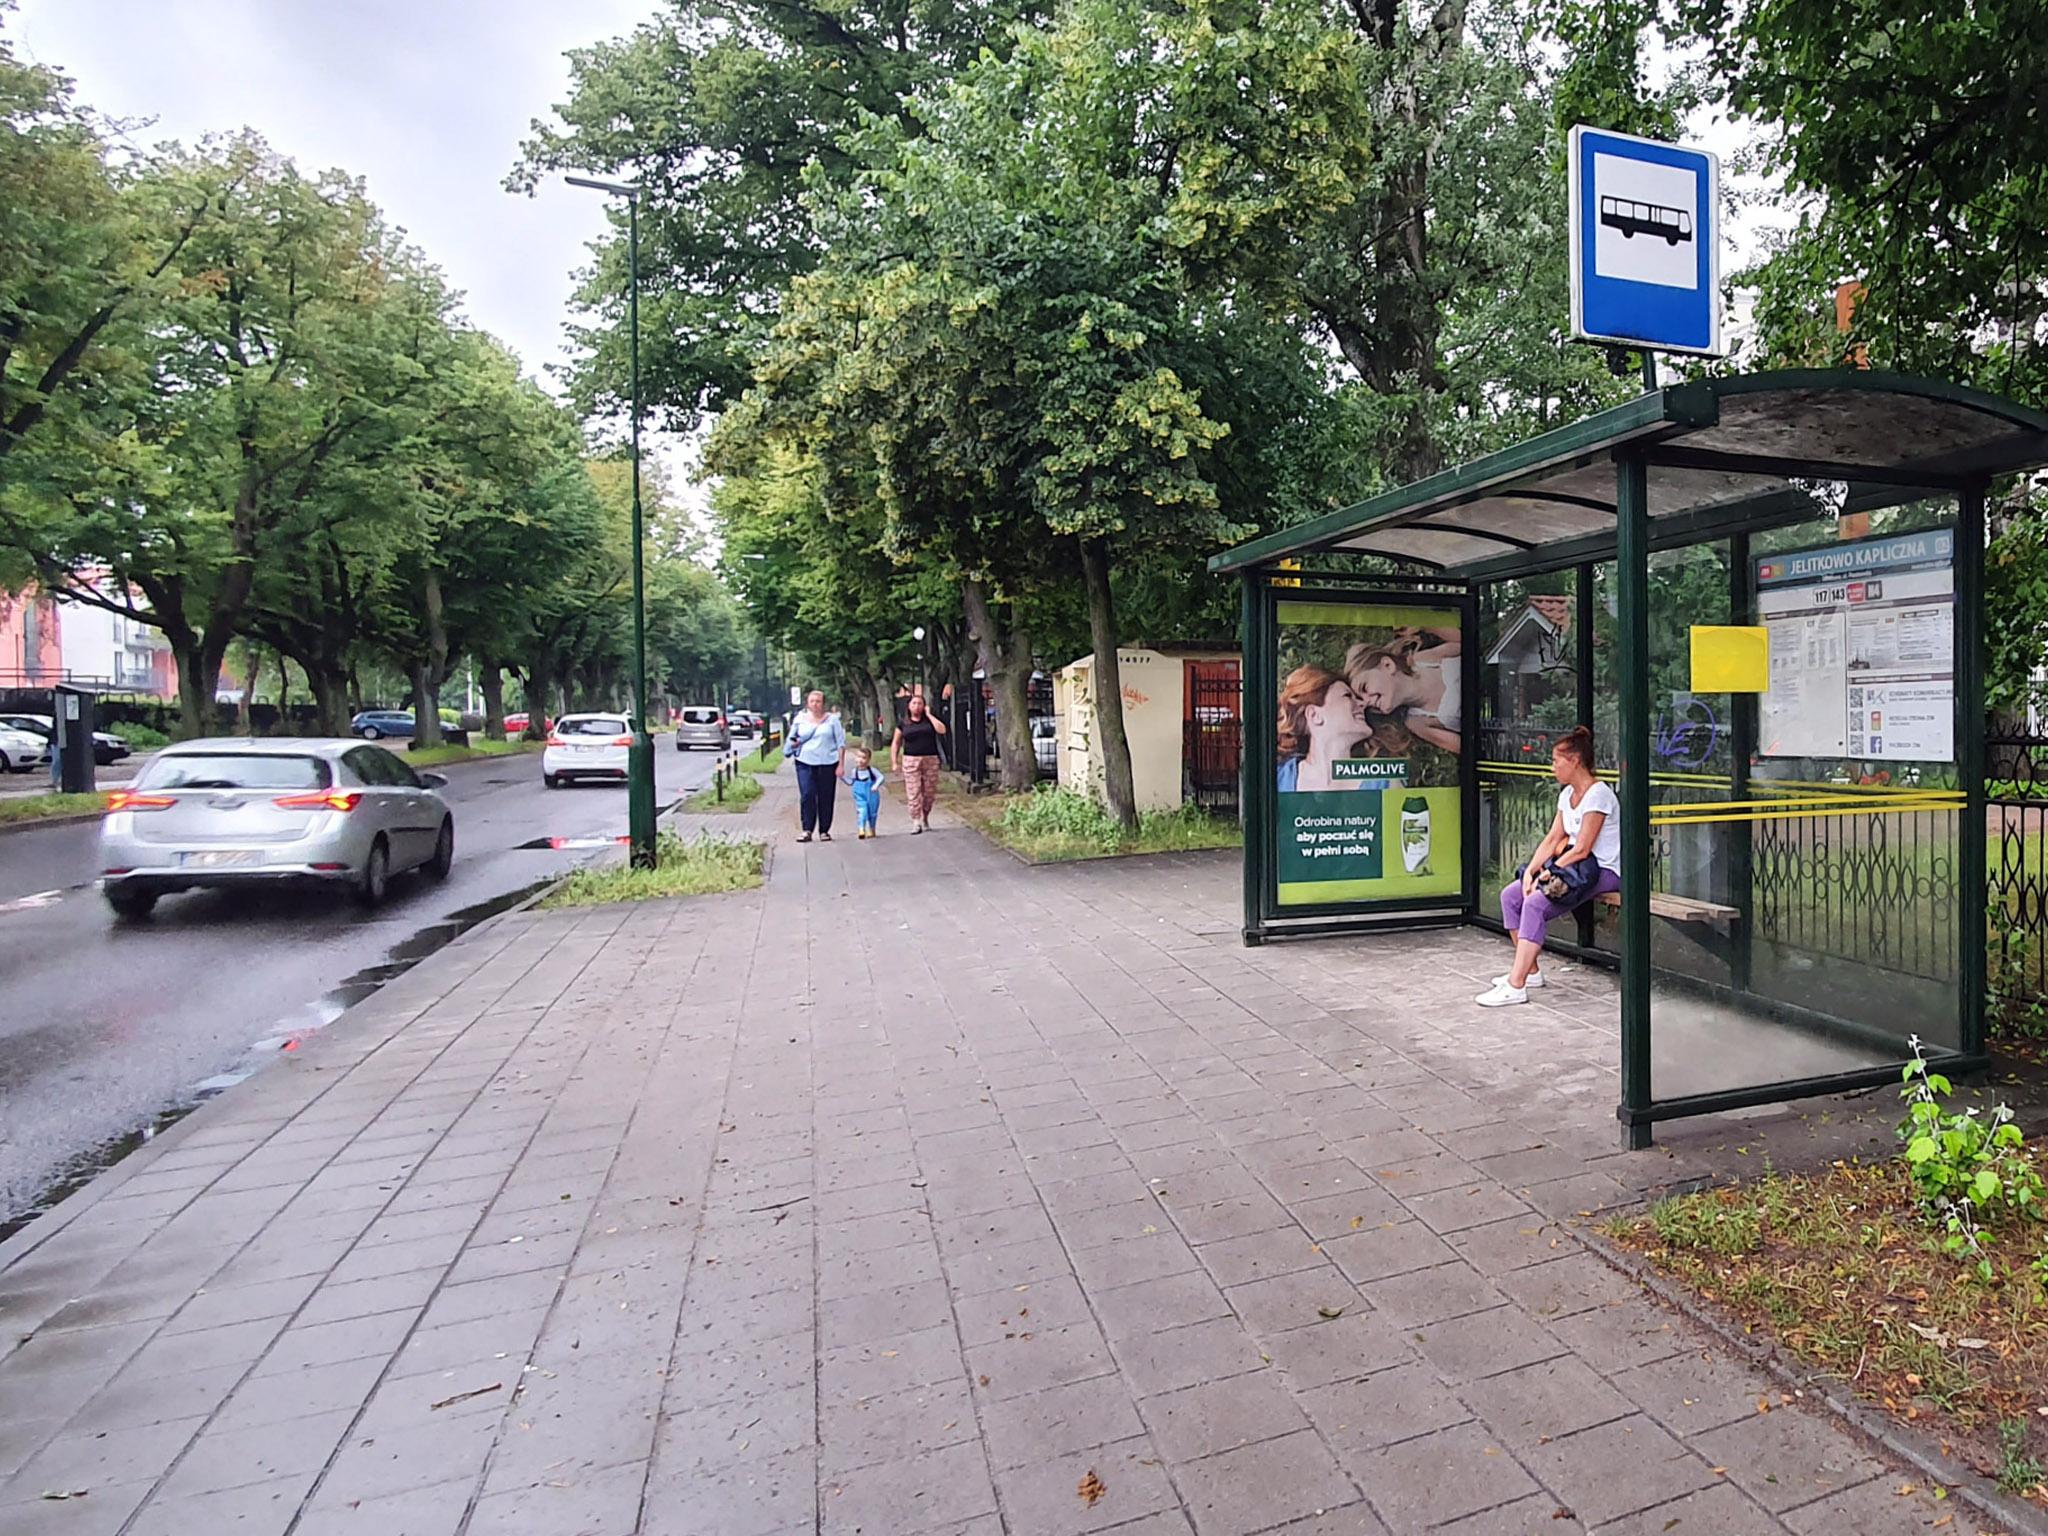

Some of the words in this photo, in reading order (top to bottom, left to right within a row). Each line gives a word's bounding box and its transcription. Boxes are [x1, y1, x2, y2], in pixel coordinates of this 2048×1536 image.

[1790, 552, 1853, 575] JELITKOWO
[1855, 541, 1926, 565] KAPLICZNA
[1815, 591, 1828, 603] 117
[1831, 588, 1845, 601] 143
[1335, 763, 1405, 775] PALMOLIVE
[1294, 817, 1342, 827] Odrobina
[1344, 816, 1376, 827] natury
[1296, 831, 1317, 844] aby
[1318, 829, 1357, 843] poczuć
[1358, 829, 1374, 841] się
[1301, 848, 1313, 857] w
[1314, 845, 1342, 858] pełni
[1343, 844, 1370, 856] sobą
